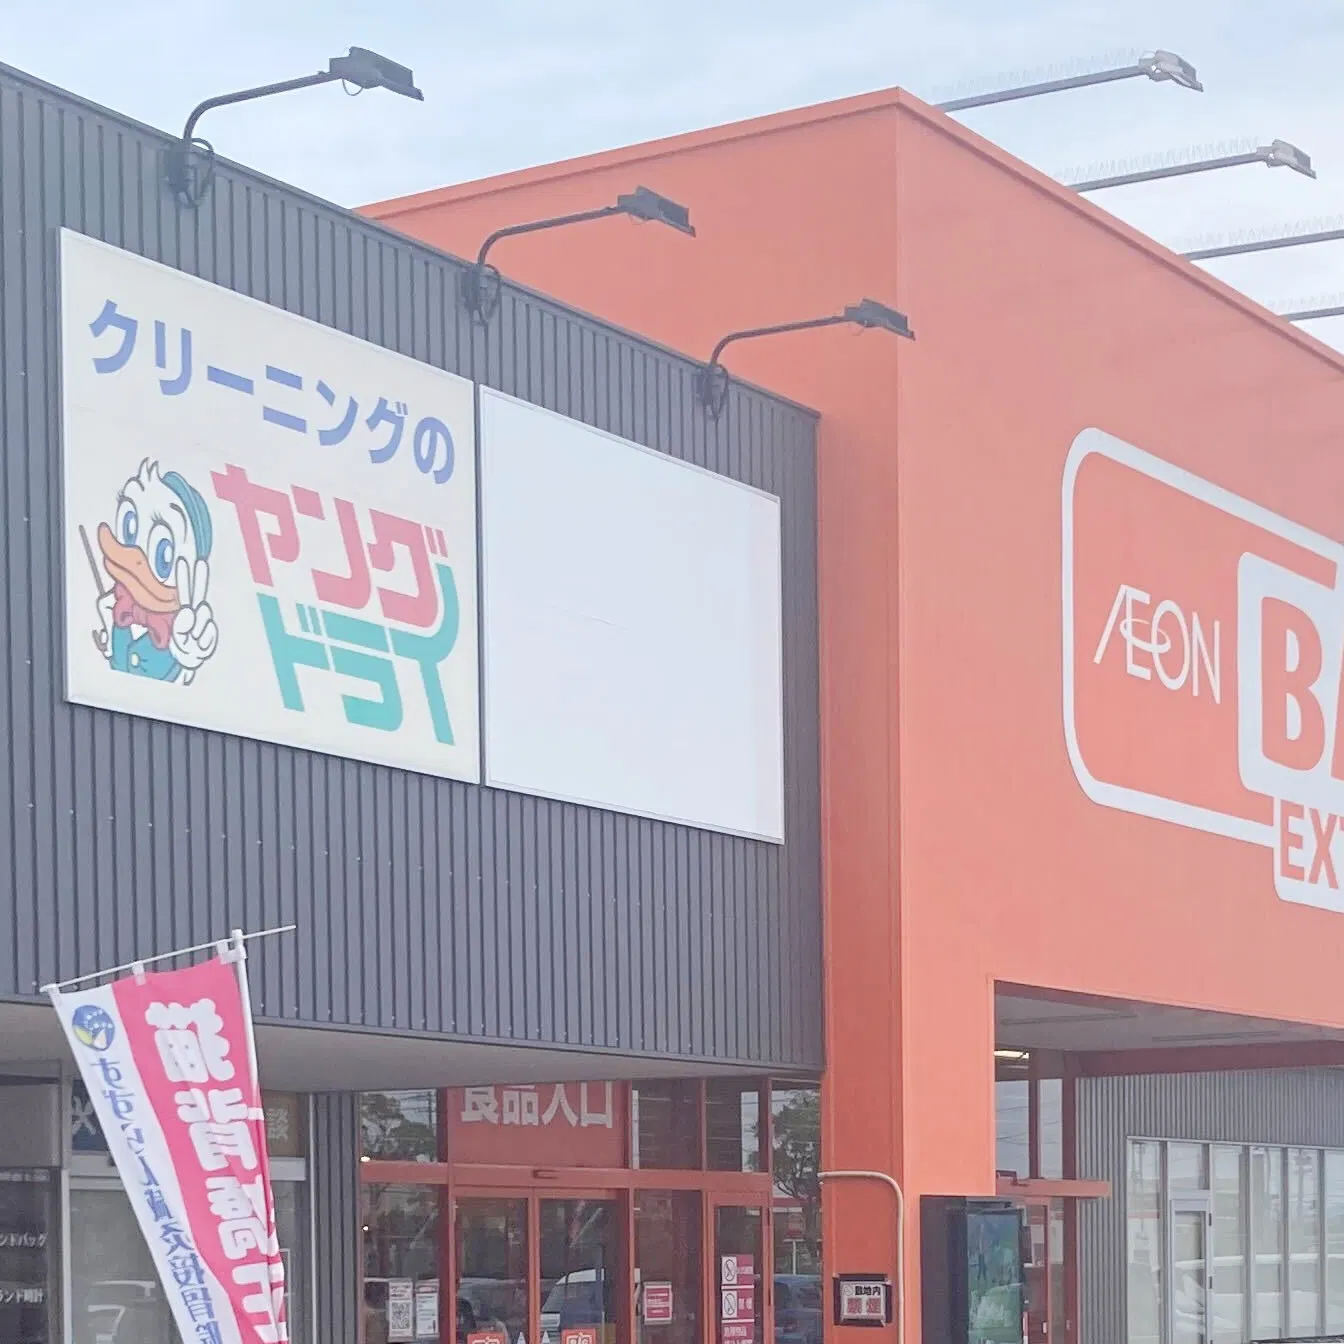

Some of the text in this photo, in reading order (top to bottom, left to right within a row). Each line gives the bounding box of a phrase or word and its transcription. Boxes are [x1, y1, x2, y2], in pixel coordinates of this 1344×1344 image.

[88, 298, 456, 485] クリーニングの
[210, 462, 452, 628] ヤング
[257, 562, 461, 746] ドライ
